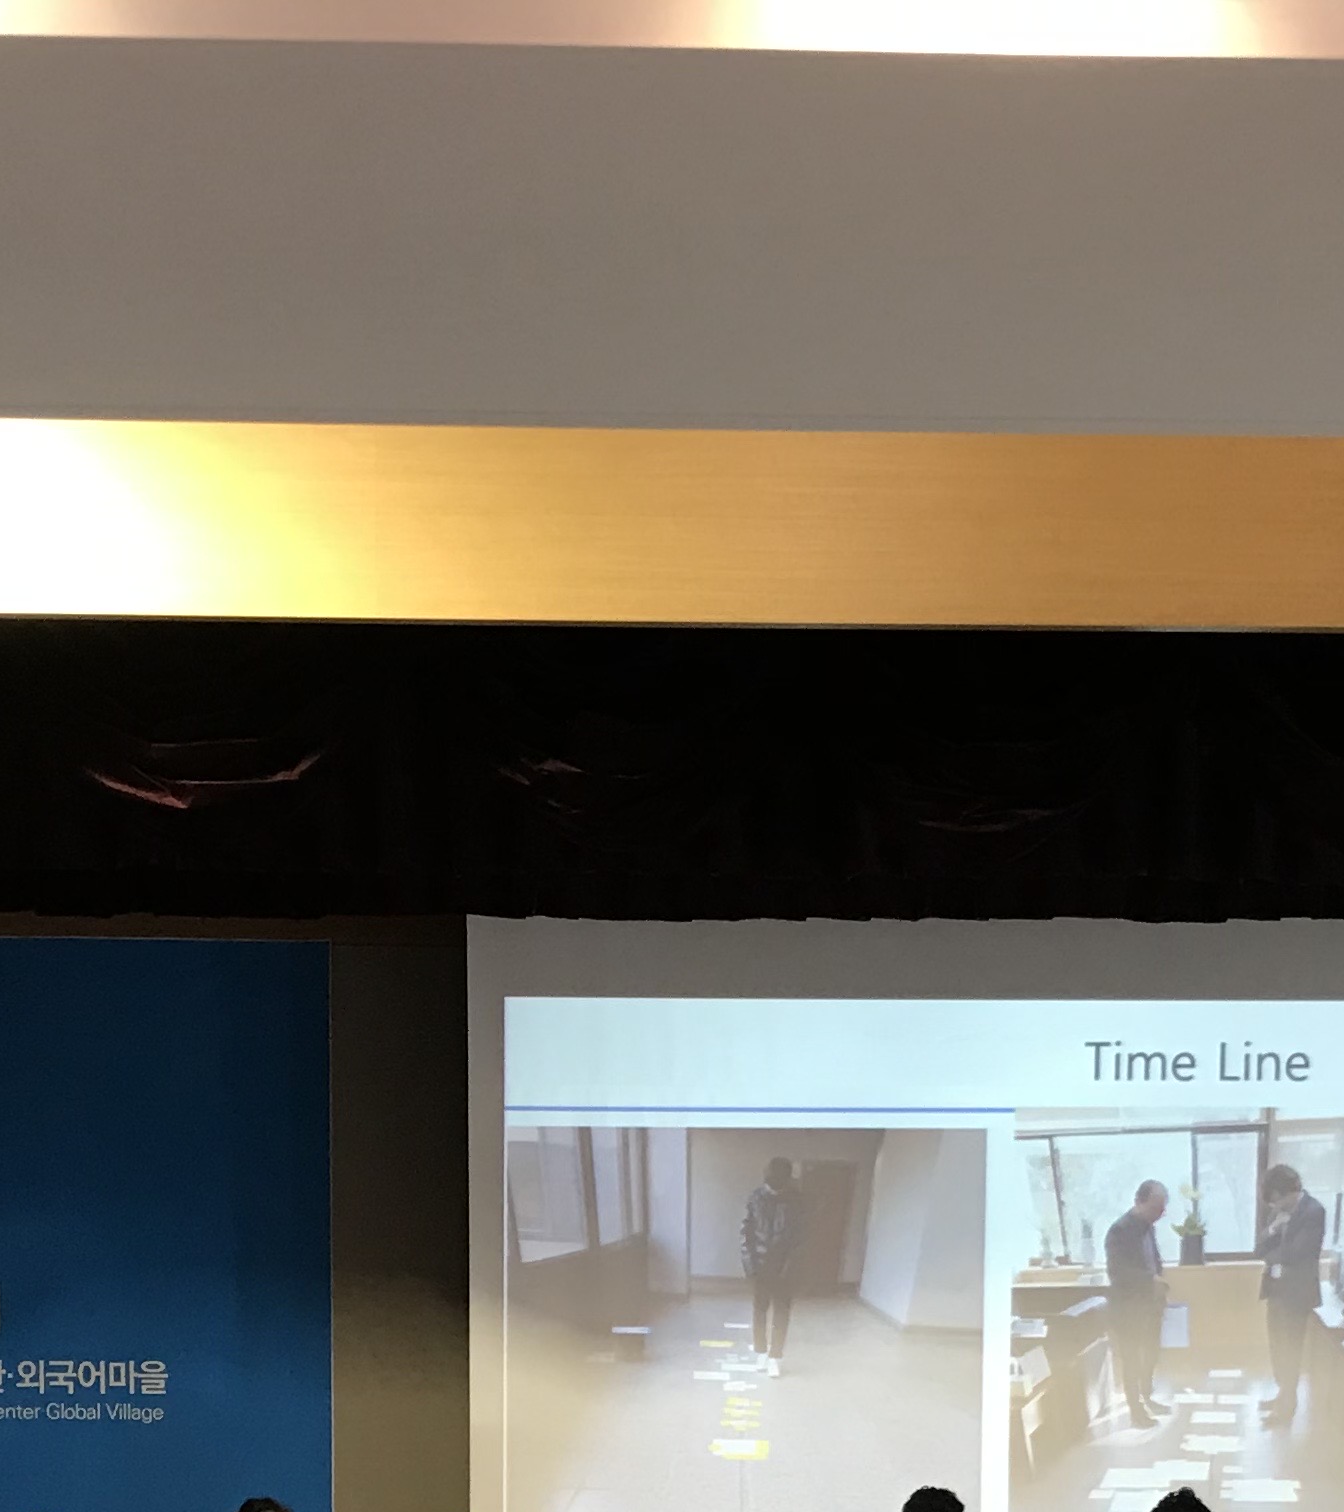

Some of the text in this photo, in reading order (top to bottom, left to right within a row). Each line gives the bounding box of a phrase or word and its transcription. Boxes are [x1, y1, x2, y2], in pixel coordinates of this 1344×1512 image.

[1084, 1040, 1310, 1082] Time Line
[45, 1402, 101, 1421] Global
[105, 1402, 164, 1423] Village
